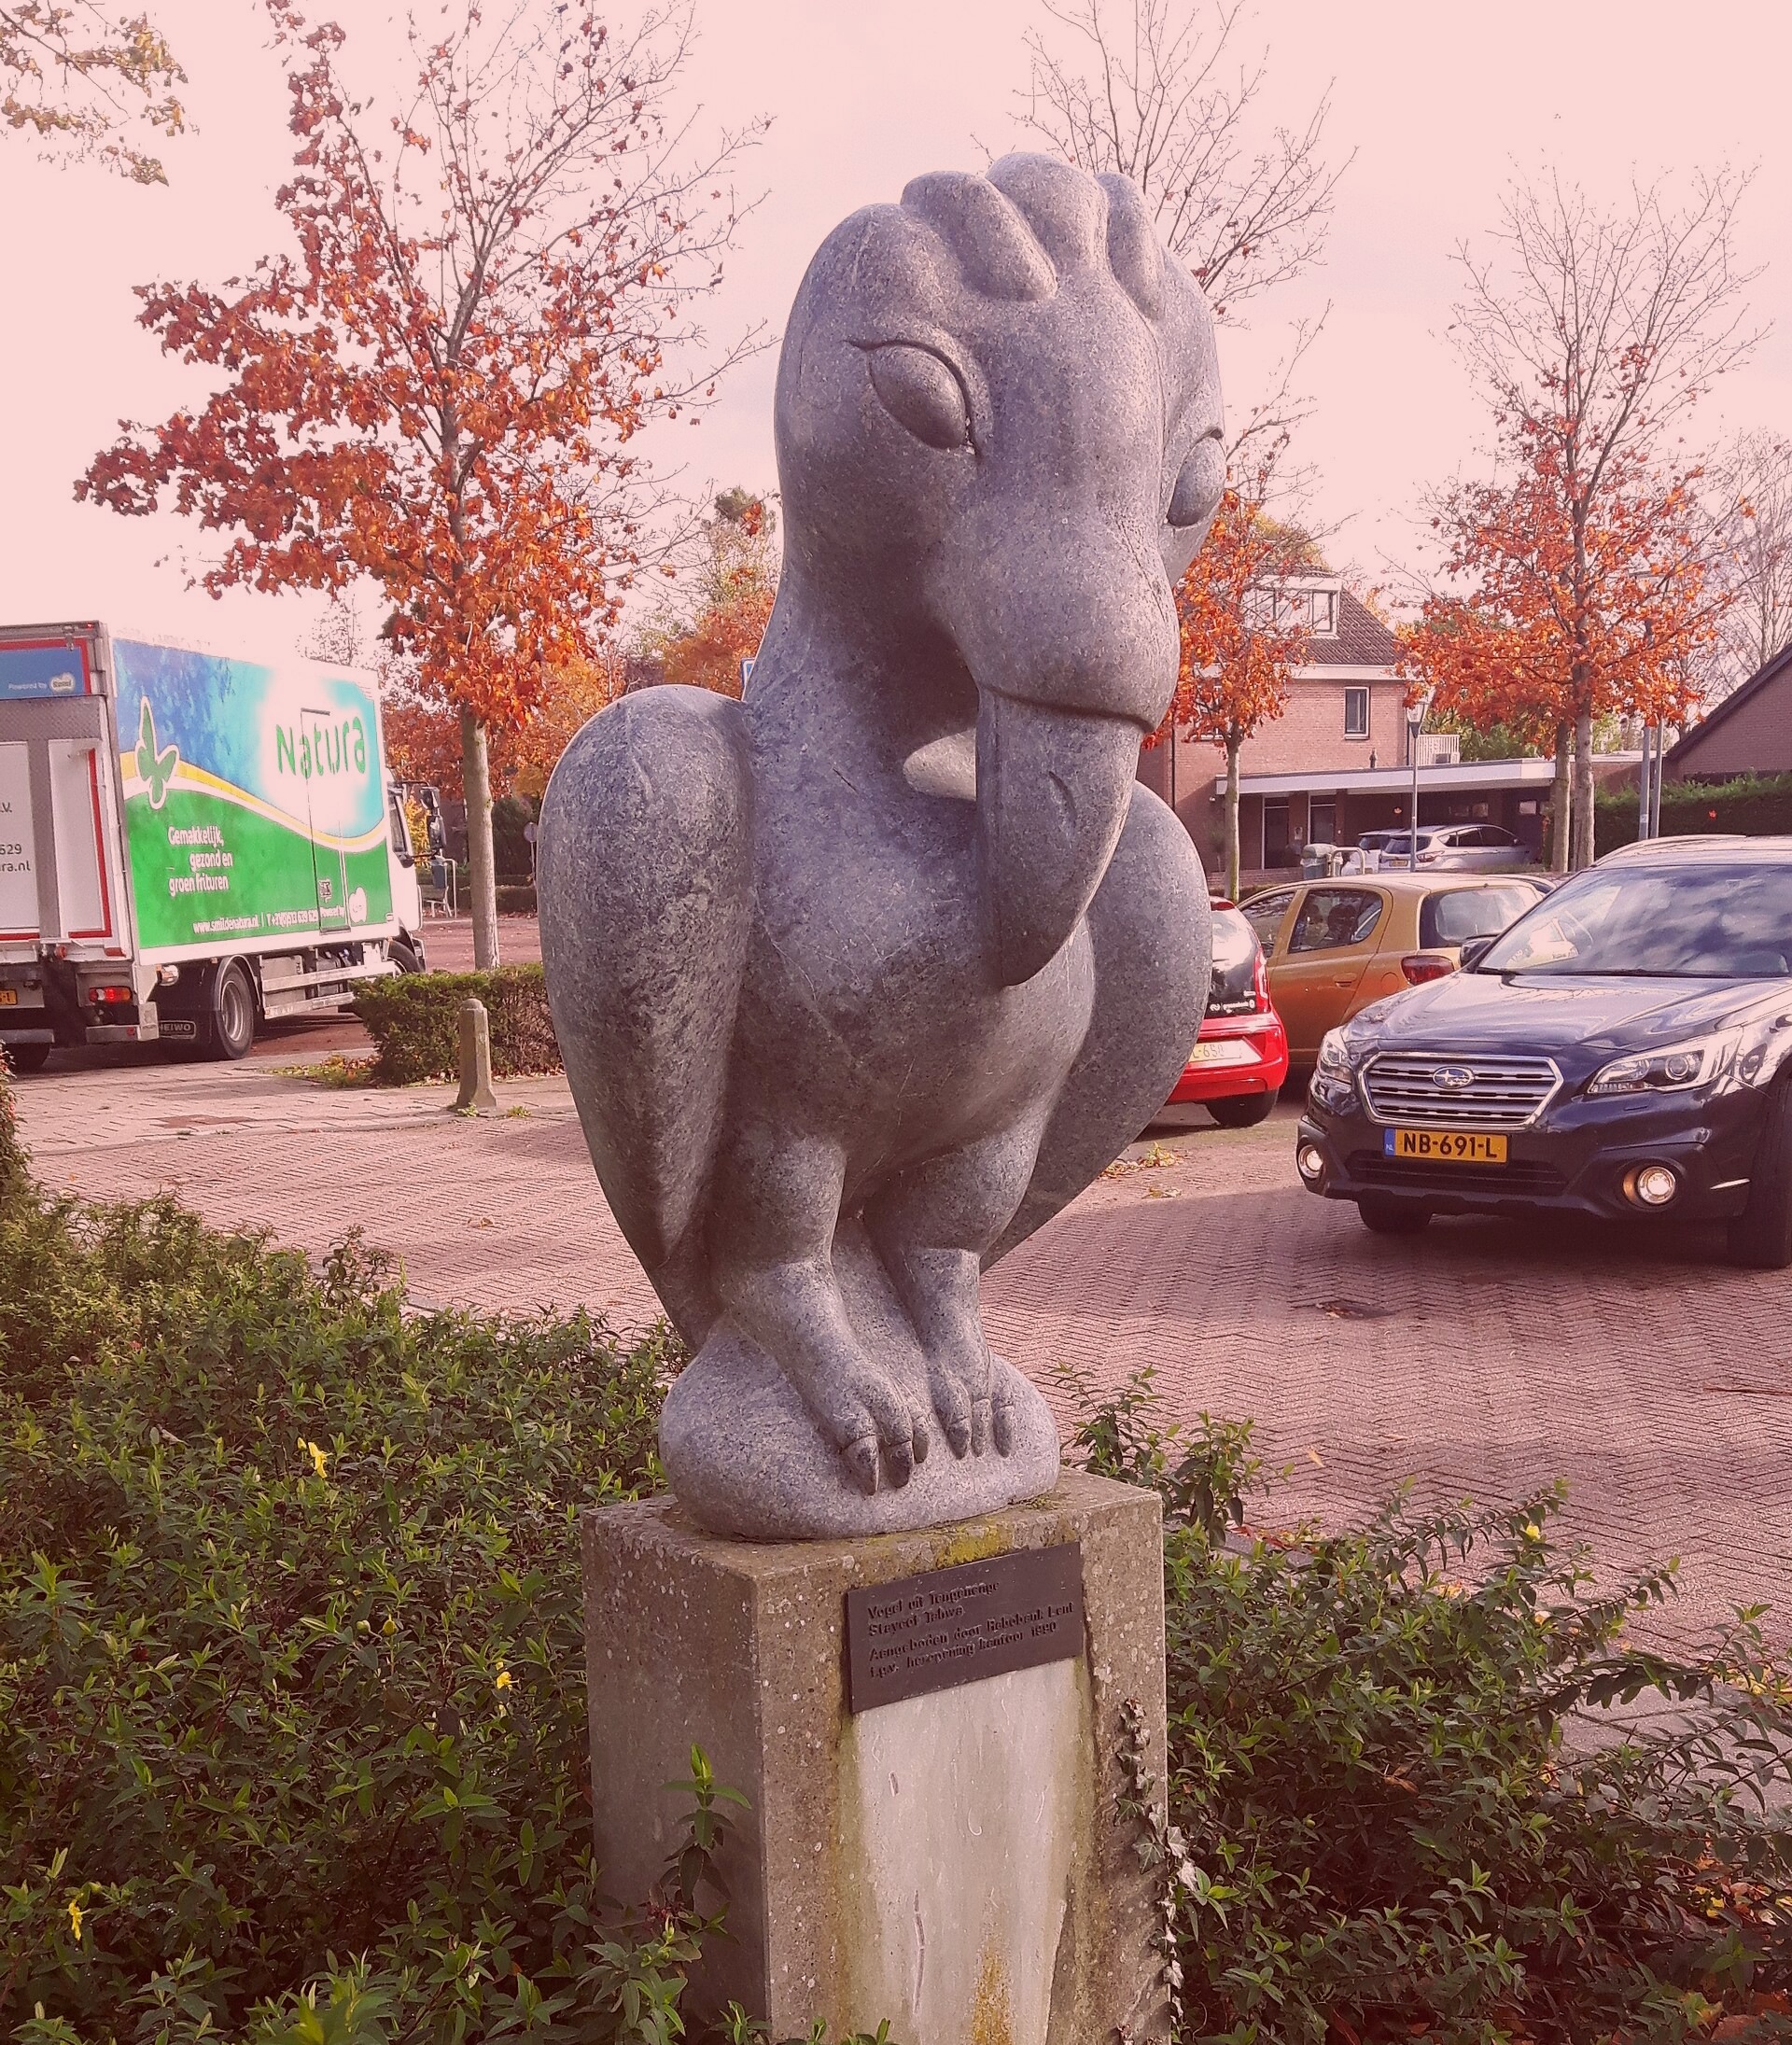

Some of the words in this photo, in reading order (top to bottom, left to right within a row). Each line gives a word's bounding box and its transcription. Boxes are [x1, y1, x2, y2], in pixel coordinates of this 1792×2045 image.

[275, 716, 366, 779] Natura
[168, 825, 225, 848] Gemakkelijk,
[0, 860, 31, 872] ra.nl
[189, 848, 221, 873] gezond
[222, 851, 233, 867] en
[169, 876, 196, 897] groen
[196, 873, 230, 891] frituren
[1403, 1132, 1498, 1159] NB-691-L
[867, 1599, 903, 1619] Vogel
[908, 1594, 924, 1611] uit
[869, 1632, 948, 1661] Aangeboden
[954, 1624, 981, 1641] door
[987, 1609, 1044, 1633] Rabobank
[1048, 1601, 1074, 1618] Lent
[906, 1642, 976, 1669] heropening
[978, 1632, 1024, 1651] kantoor
